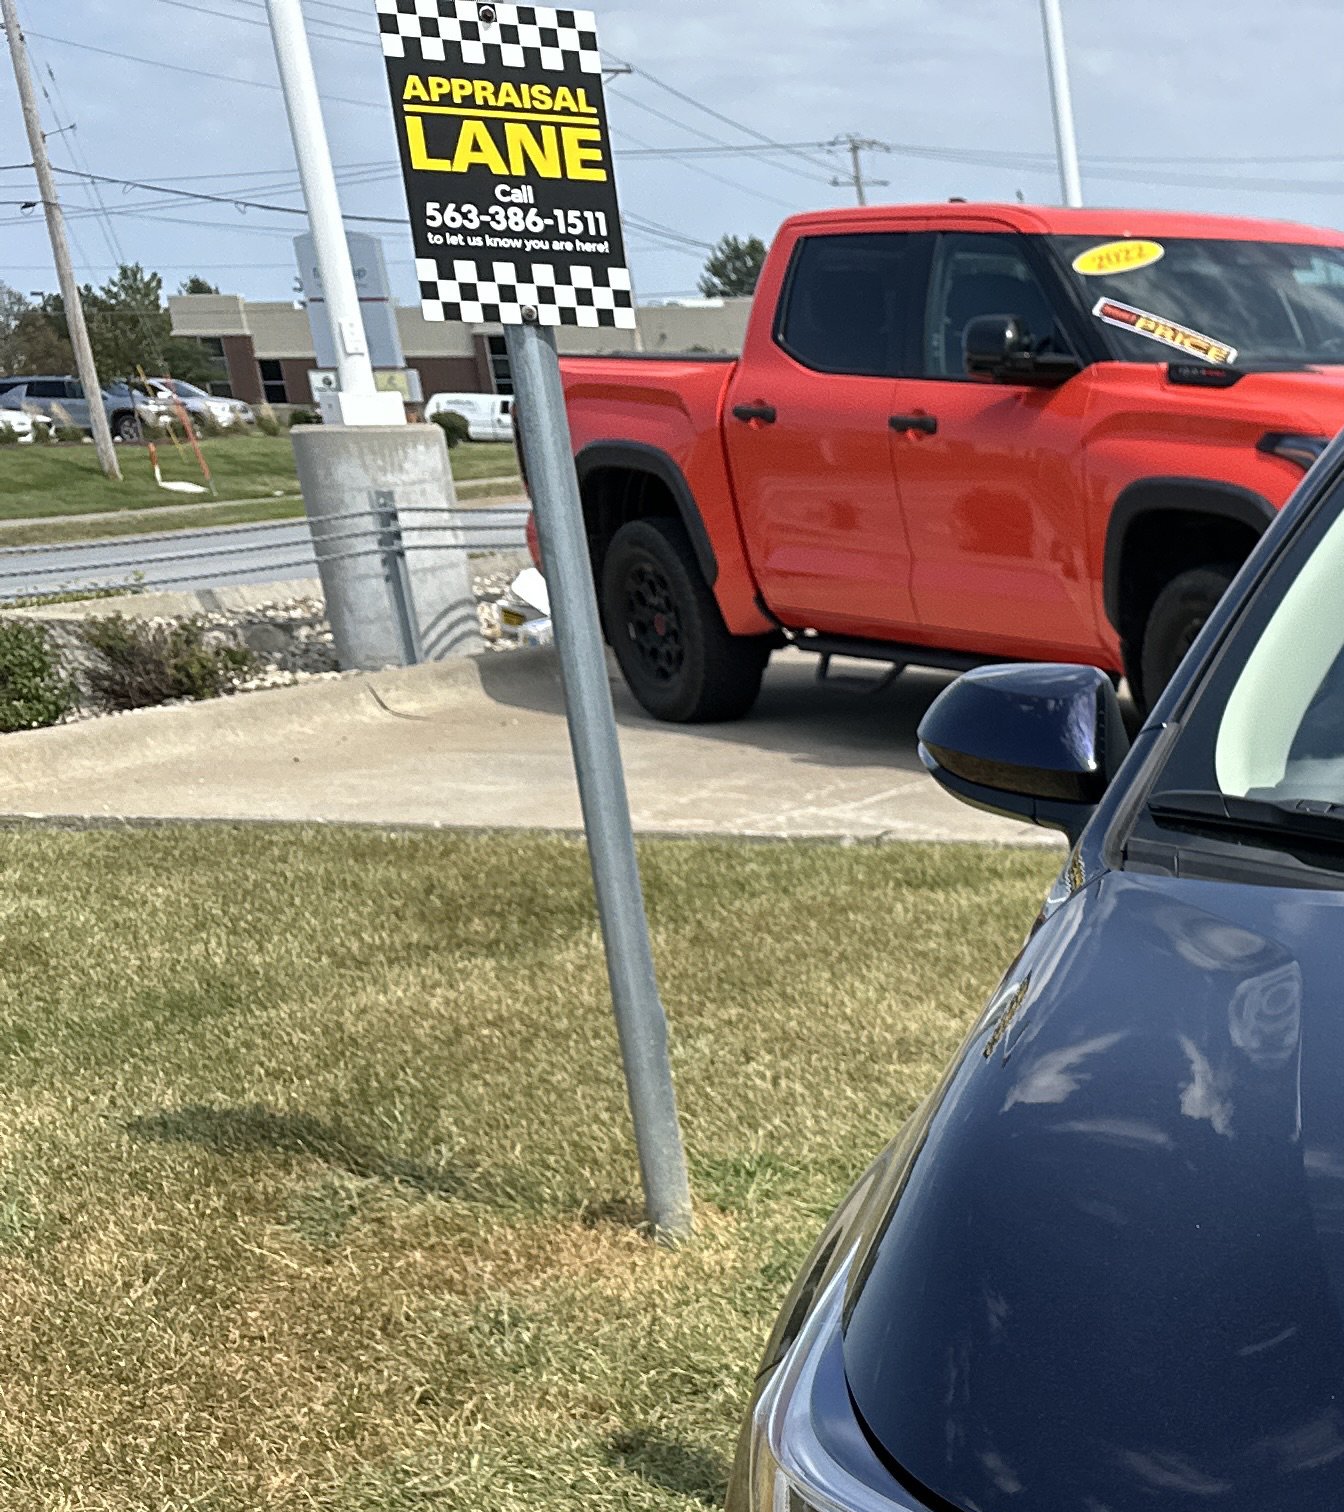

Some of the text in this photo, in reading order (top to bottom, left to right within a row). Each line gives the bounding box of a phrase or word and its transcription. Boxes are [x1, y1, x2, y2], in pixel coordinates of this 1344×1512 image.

[402, 74, 598, 114] APPRAISAL
[404, 115, 608, 182] LANE
[494, 183, 535, 204] Call
[425, 201, 608, 237] 563-386-1511
[427, 232, 610, 254] to let us know you are here!
[1135, 315, 1231, 364] PRICE
